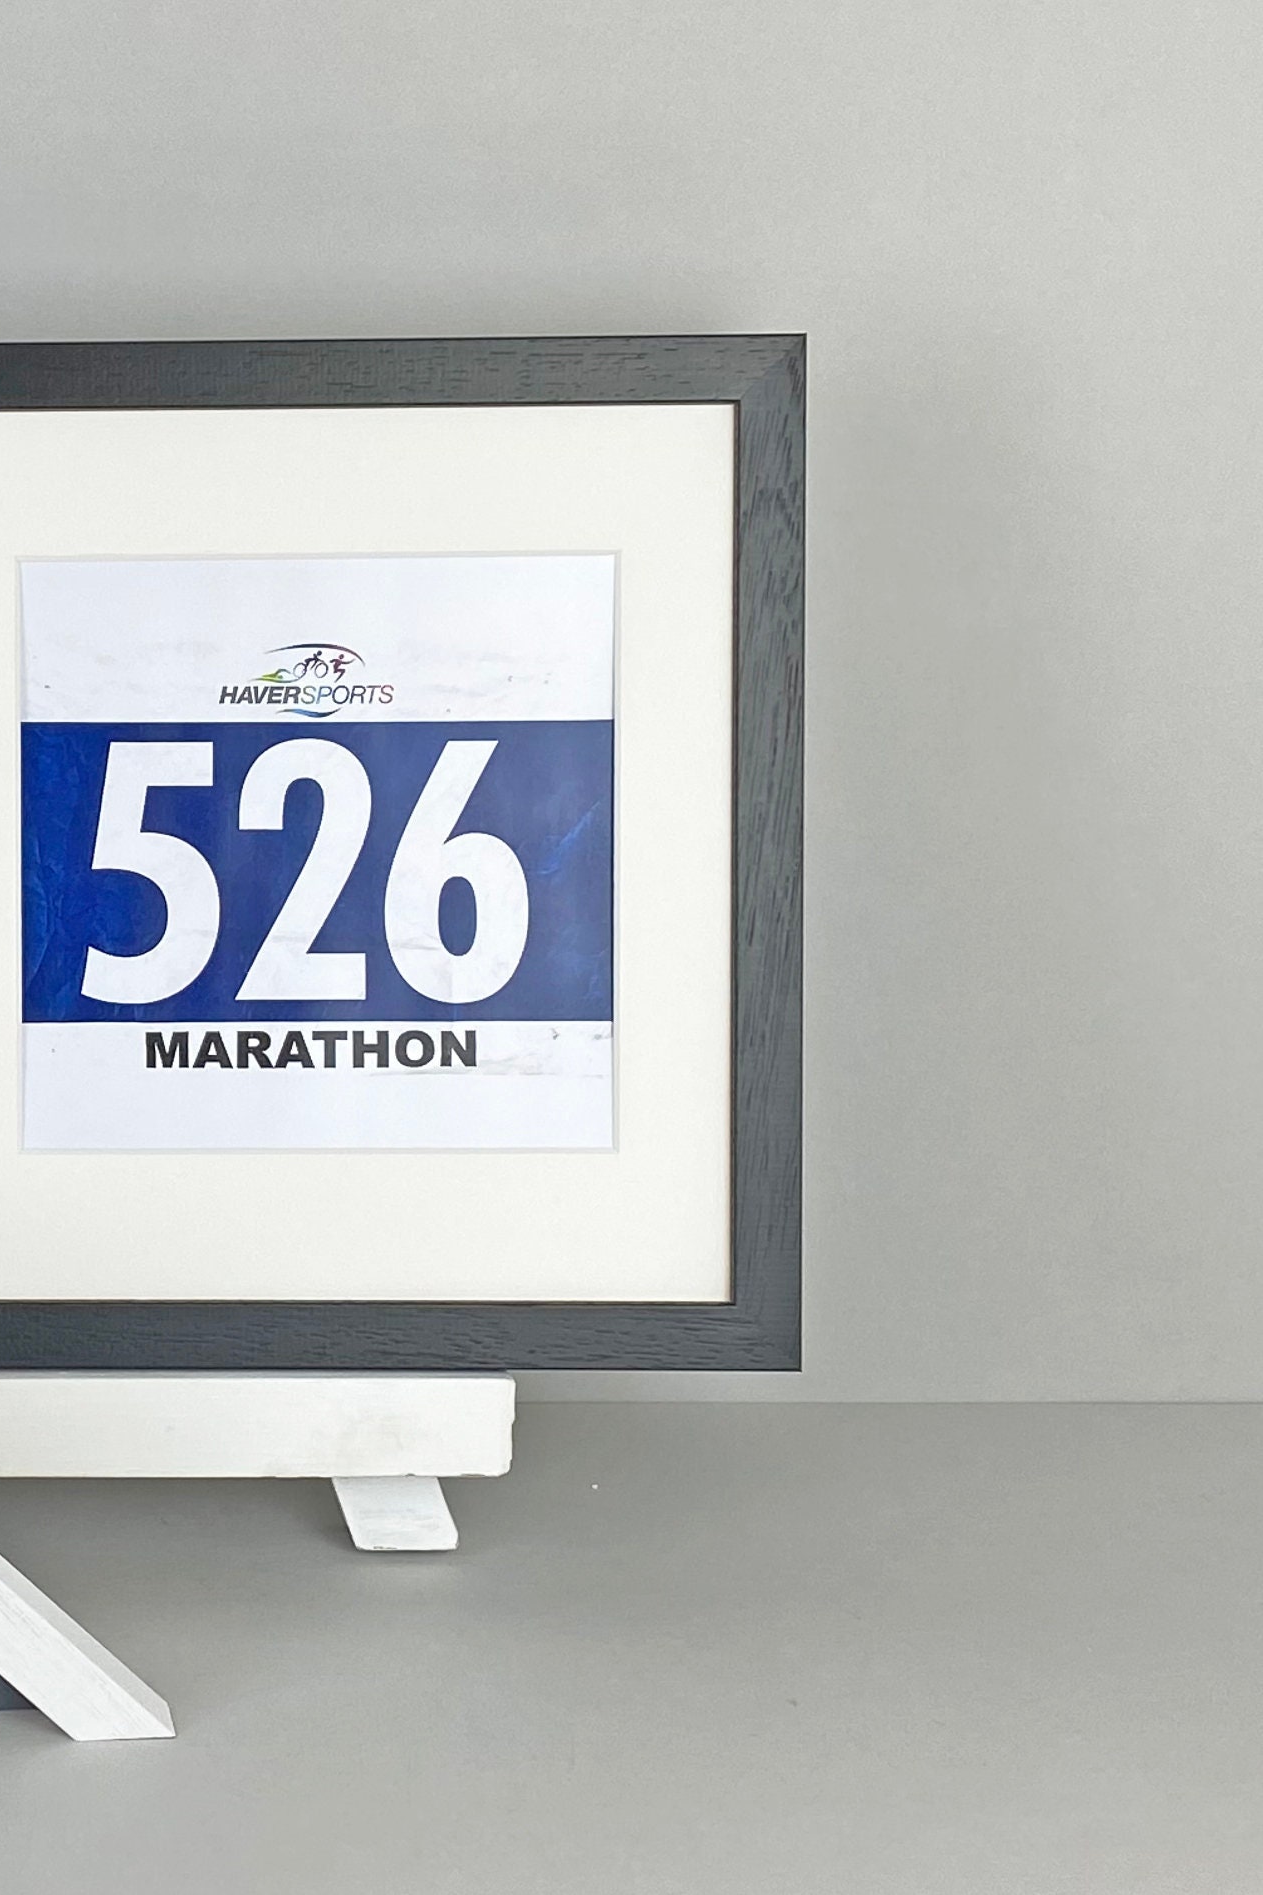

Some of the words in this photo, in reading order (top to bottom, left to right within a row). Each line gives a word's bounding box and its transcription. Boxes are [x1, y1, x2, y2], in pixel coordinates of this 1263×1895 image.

[218, 684, 395, 705] HAVERSPORTS
[80, 738, 529, 1004] 526
[145, 1029, 478, 1069] MARATHON
